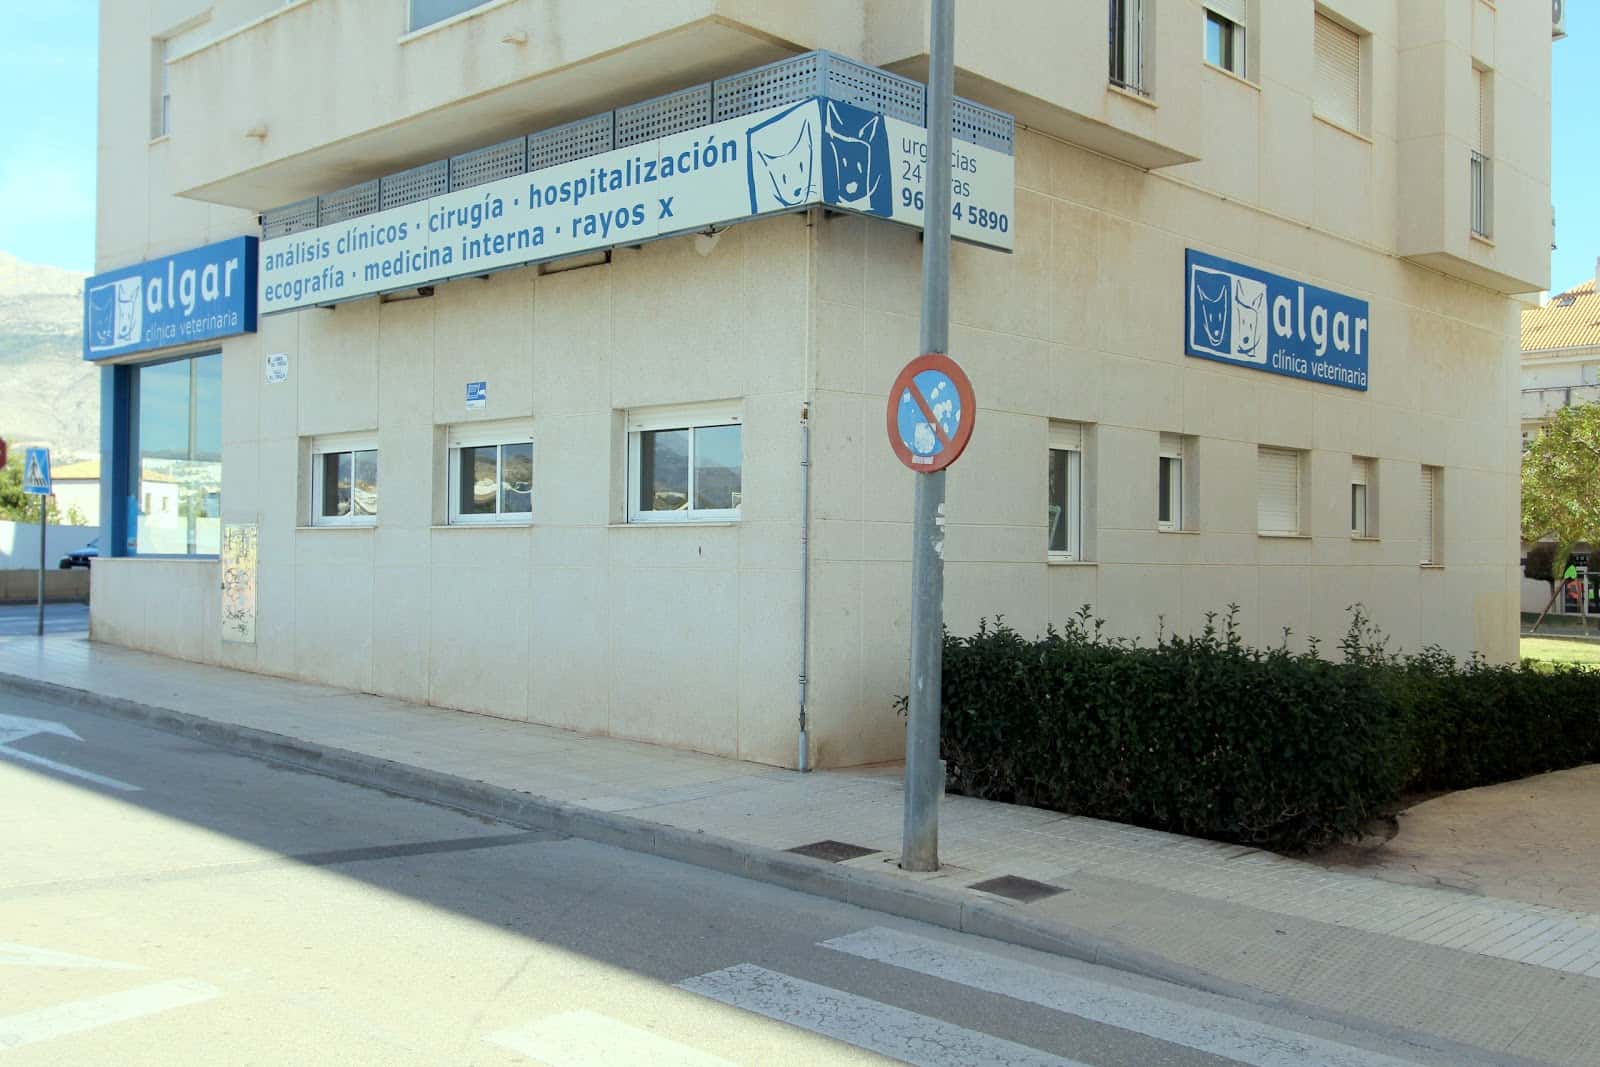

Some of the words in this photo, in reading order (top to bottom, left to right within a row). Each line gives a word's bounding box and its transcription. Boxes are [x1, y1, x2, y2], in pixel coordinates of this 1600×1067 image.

[902, 160, 922, 183] 24
[265, 238, 330, 272] análisis
[336, 221, 408, 255] clínicos
[428, 192, 504, 233] cirugía
[529, 135, 738, 210] hospitalización
[902, 187, 924, 211] 96
[968, 205, 1009, 233] 5890
[265, 264, 345, 301] ecografía
[364, 244, 453, 282] medicina
[462, 224, 545, 261] interna
[571, 203, 646, 239] rayos
[658, 196, 674, 220] x
[146, 257, 239, 317] algar
[179, 310, 239, 335] veterinaria
[1272, 286, 1368, 357] algar
[1311, 361, 1367, 386] veterinaria
